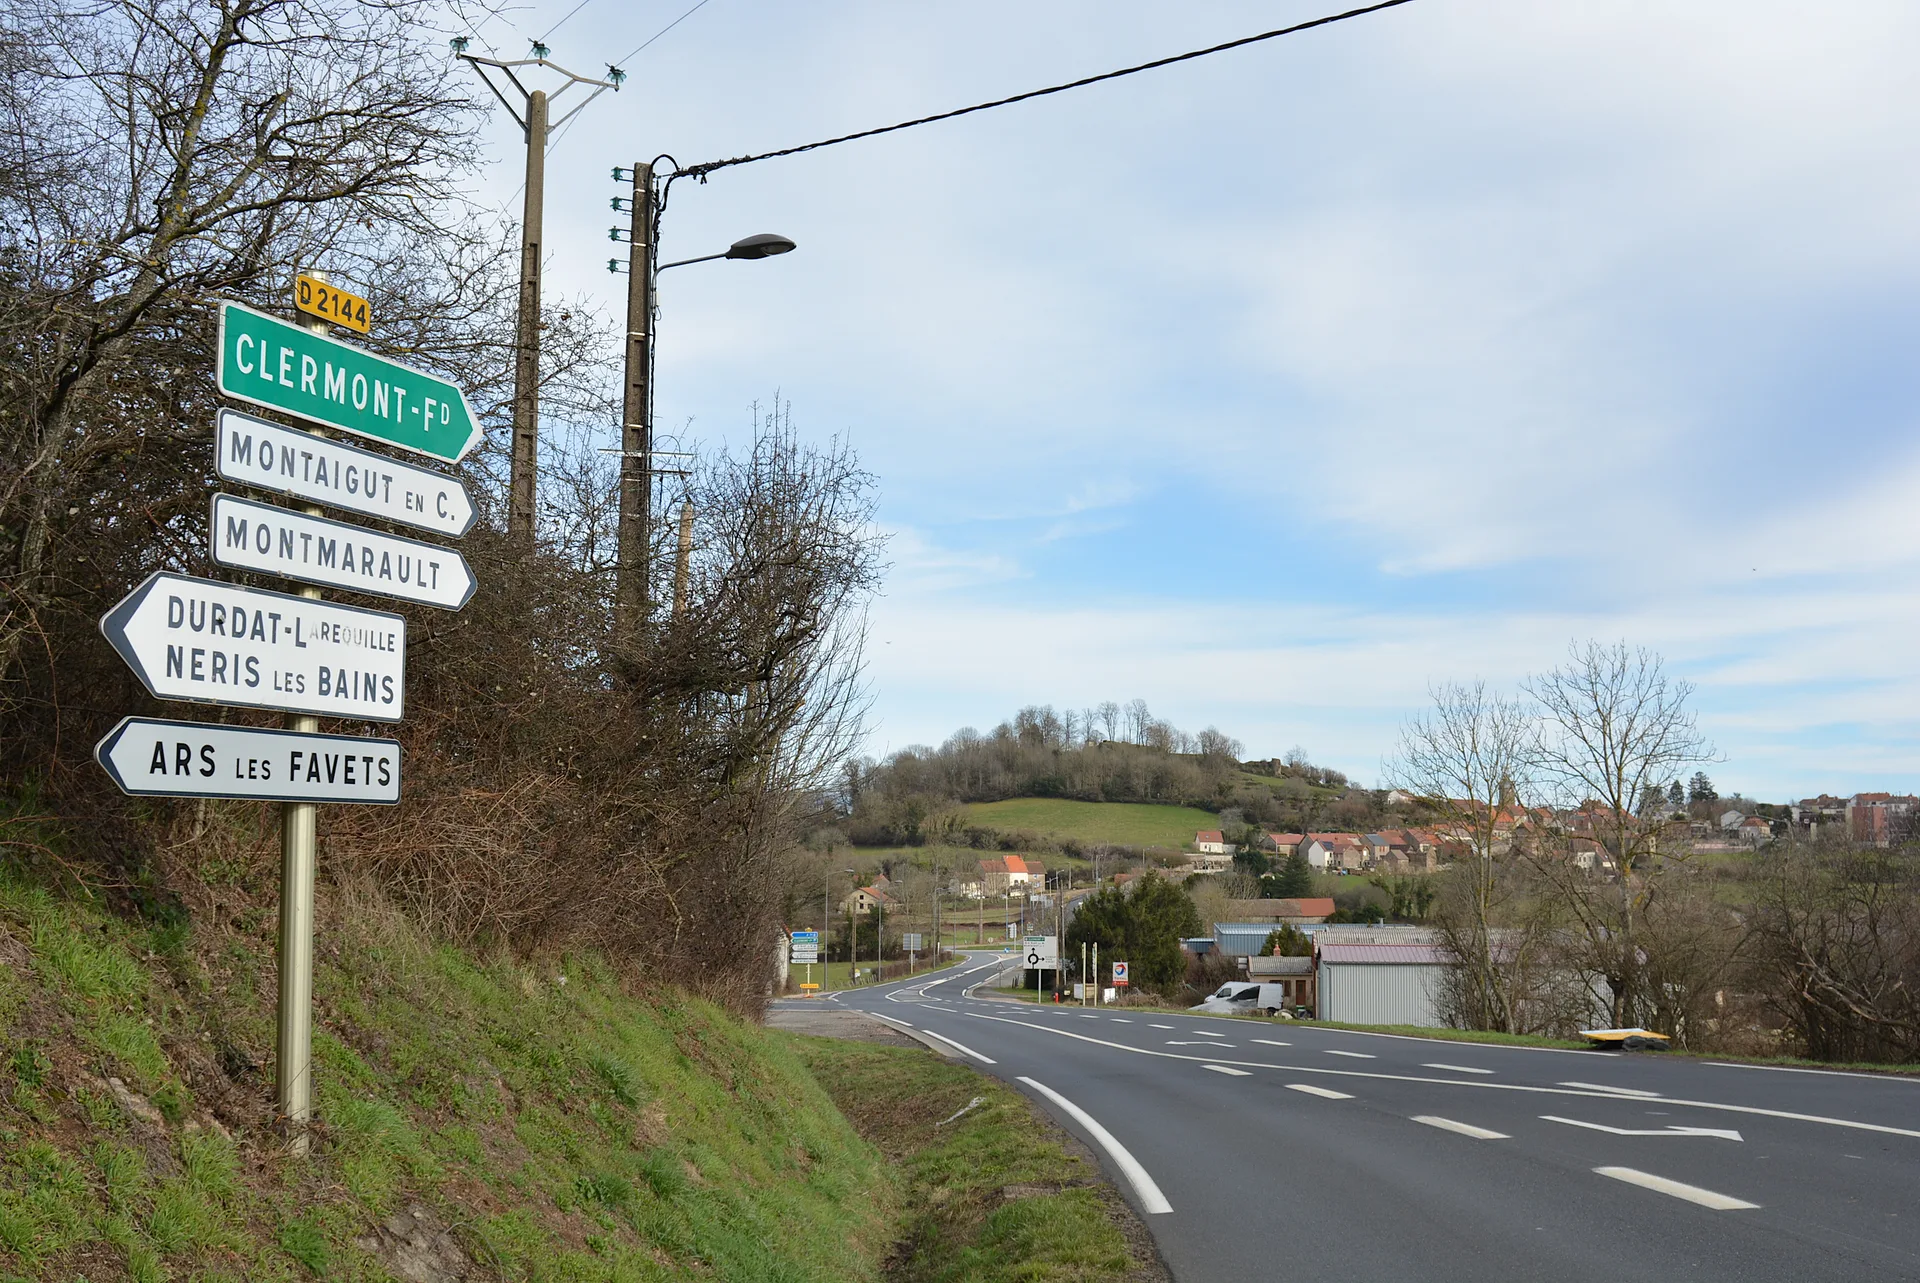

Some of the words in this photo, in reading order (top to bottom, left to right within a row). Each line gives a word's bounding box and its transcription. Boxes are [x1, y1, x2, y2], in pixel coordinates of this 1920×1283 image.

[300, 280, 312, 305] D
[317, 288, 367, 327] 2144
[231, 431, 393, 504] MONTAIGUT
[405, 491, 424, 513] EN
[436, 492, 456, 521] C.
[226, 515, 440, 590] MONTMARAULT
[166, 644, 261, 688] NERIS
[274, 670, 305, 694] LES
[318, 666, 395, 705] BAINS
[149, 741, 216, 778] ARS
[235, 757, 271, 780] LES
[289, 751, 391, 786] FAVETS
